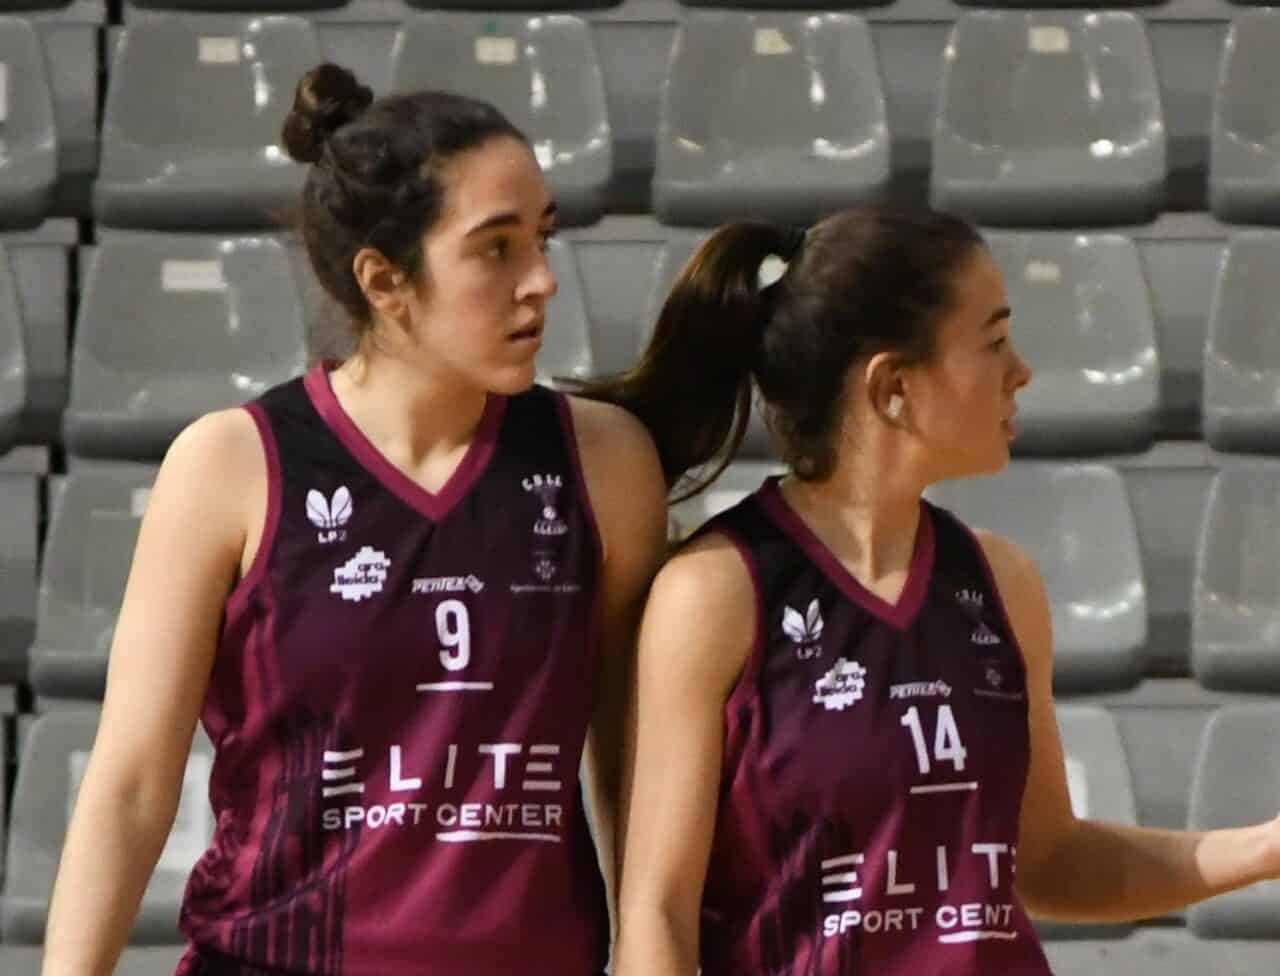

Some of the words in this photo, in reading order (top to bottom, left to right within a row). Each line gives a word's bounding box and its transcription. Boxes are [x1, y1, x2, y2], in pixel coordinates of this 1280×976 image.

[435, 599, 471, 672] 9
[901, 703, 968, 775] 14
[321, 742, 562, 798] ELITE
[322, 803, 428, 830] SPORT
[435, 803, 563, 827] CENTER
[821, 843, 1017, 903] ELIT
[823, 906, 924, 938] SPORT
[935, 902, 1014, 930] CENT
